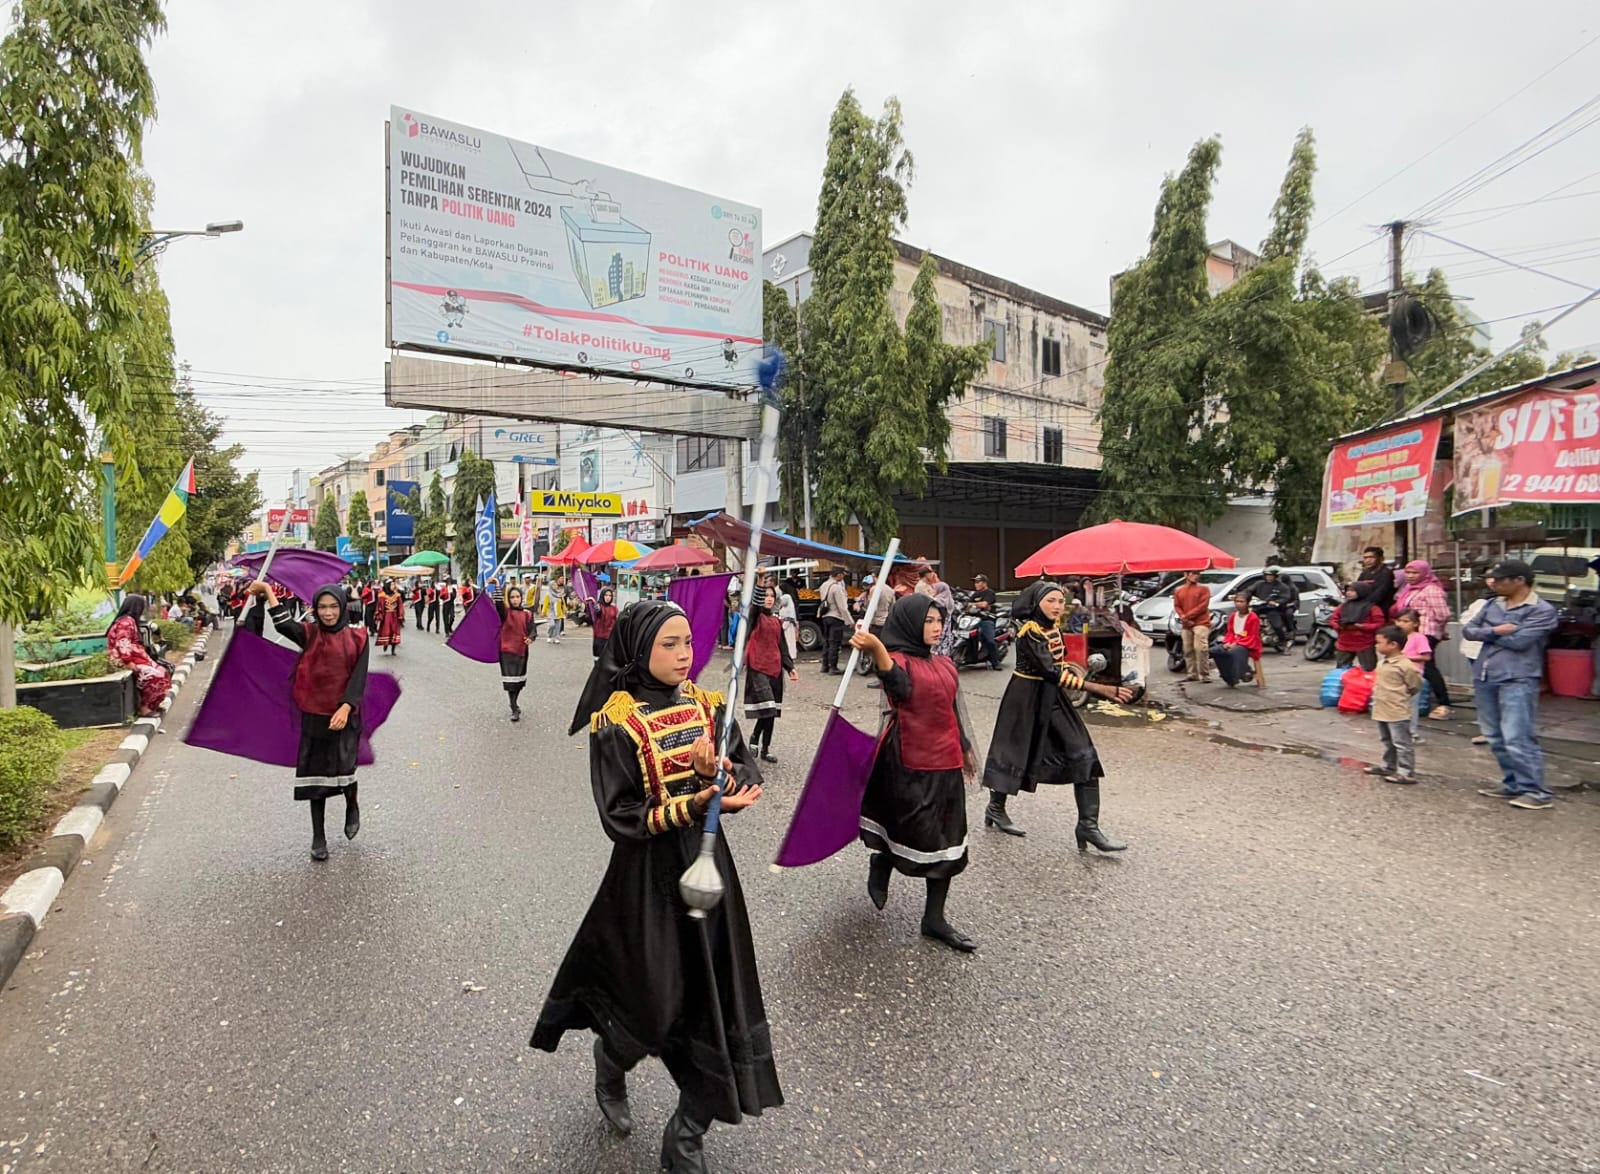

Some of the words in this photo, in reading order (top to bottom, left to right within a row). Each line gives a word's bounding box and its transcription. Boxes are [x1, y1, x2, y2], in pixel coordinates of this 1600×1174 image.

[420, 123, 481, 149] BAWASLU
[401, 151, 466, 180] WUJUDKAN
[401, 170, 465, 198] PEMILIHAN
[467, 186, 521, 212] SERENTAK
[524, 200, 552, 219] 2024
[401, 189, 439, 211] TANPA
[441, 198, 484, 221] POLITIK
[486, 209, 516, 228] UANG
[400, 219, 422, 231] Ikuti
[423, 224, 453, 236] Awasi
[454, 230, 471, 241] dan
[474, 234, 515, 251] Laporkan
[517, 243, 549, 259] Dugaan
[400, 232, 460, 251] Pelanggaran
[461, 242, 473, 253] ke
[475, 247, 518, 263] BAWASLU
[520, 256, 554, 270] Provinsi
[400, 245, 419, 256] dan
[420, 248, 494, 270] Kabupaten/Kota
[659, 252, 710, 273] POLITIK
[714, 264, 749, 281] UANG
[523, 323, 671, 361] #TolakPolitikUang
[509, 431, 544, 443] GREE
[1575, 472, 1600, 493] 68
[558, 493, 612, 511] Miyako
[478, 516, 494, 587] AQUA
